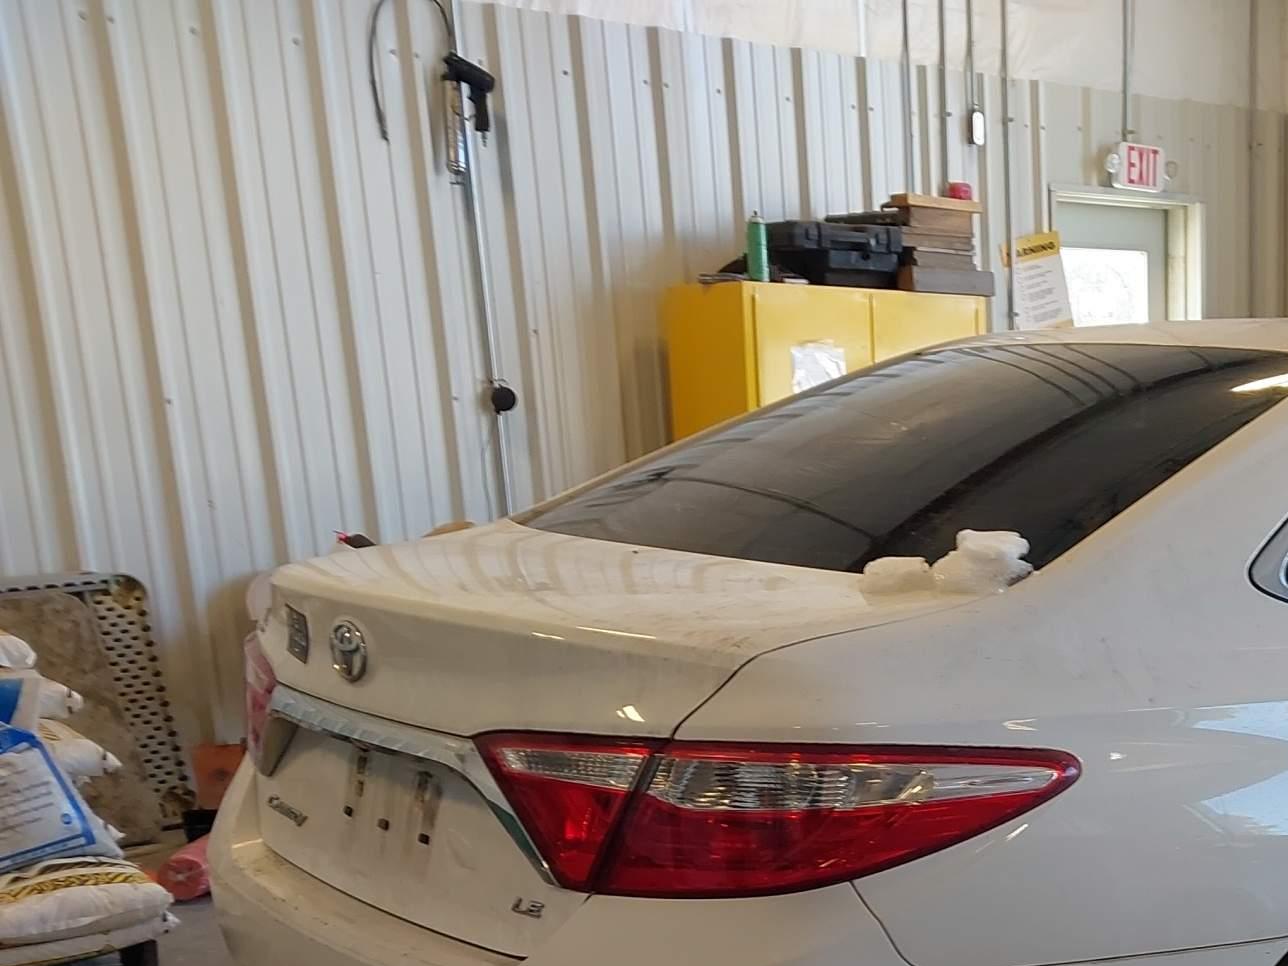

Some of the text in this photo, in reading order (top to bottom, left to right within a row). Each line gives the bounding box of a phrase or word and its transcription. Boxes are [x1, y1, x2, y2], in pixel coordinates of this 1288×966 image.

[1127, 145, 1160, 187] EXIT
[1008, 241, 1056, 258] ARNING
[511, 898, 545, 919] LE
